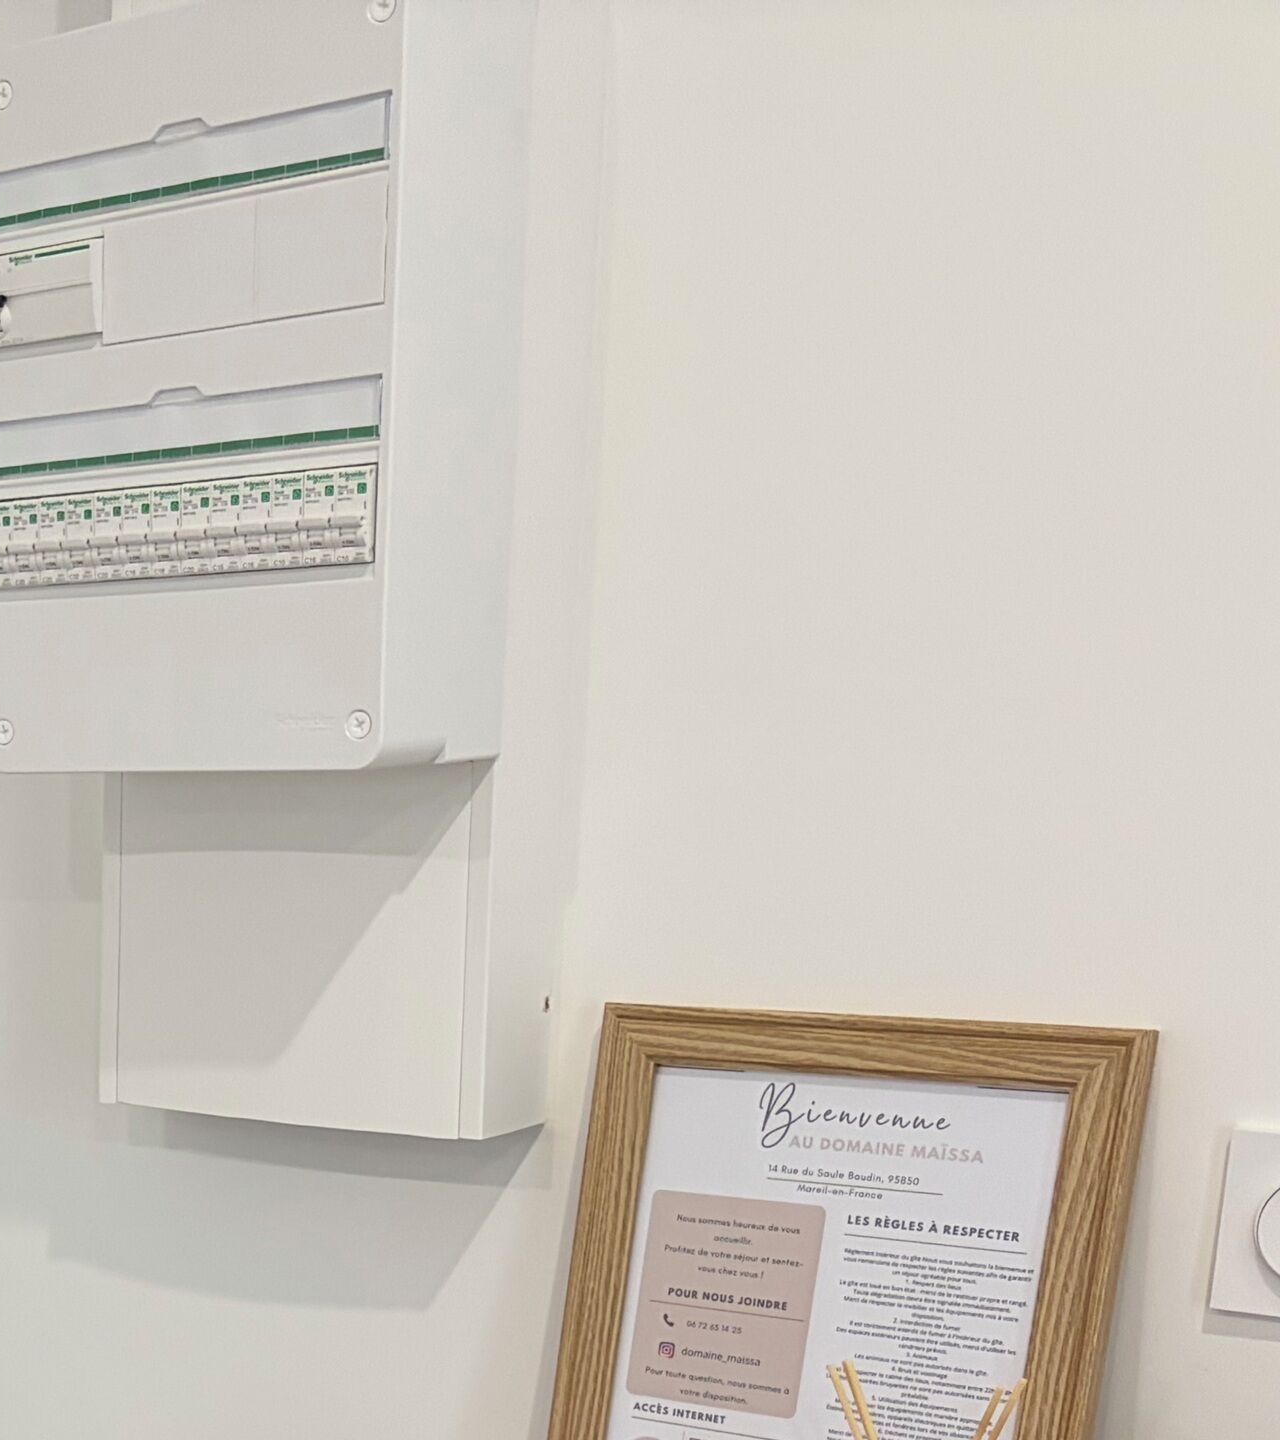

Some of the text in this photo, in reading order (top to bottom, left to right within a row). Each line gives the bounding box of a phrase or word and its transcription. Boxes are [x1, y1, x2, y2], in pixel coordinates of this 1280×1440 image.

[759, 1082, 951, 1149] Bienvenue
[790, 1135, 984, 1164] AU DOMAINE MAÏSSA
[768, 1164, 778, 1174] 14
[781, 1165, 799, 1176] Rue
[802, 1168, 815, 1177] du
[887, 1174, 920, 1187] 95850
[796, 1183, 883, 1201] Mareil-en-France
[676, 1214, 696, 1223] Nous
[768, 1224, 779, 1232] de
[781, 1227, 801, 1235] vous
[847, 1214, 1020, 1243] LES RÈGLES À RESPECTER
[698, 1248, 708, 1257] de
[761, 1256, 770, 1264] et
[740, 1270, 758, 1279] vous
[668, 1287, 788, 1311] POUR NOUS JOINDRE
[645, 1366, 663, 1376] Pour
[665, 1369, 686, 1380] toute
[727, 1380, 746, 1389] nous
[748, 1382, 781, 1394] sommes
[633, 1402, 726, 1425] ACCÈS INTERNET
